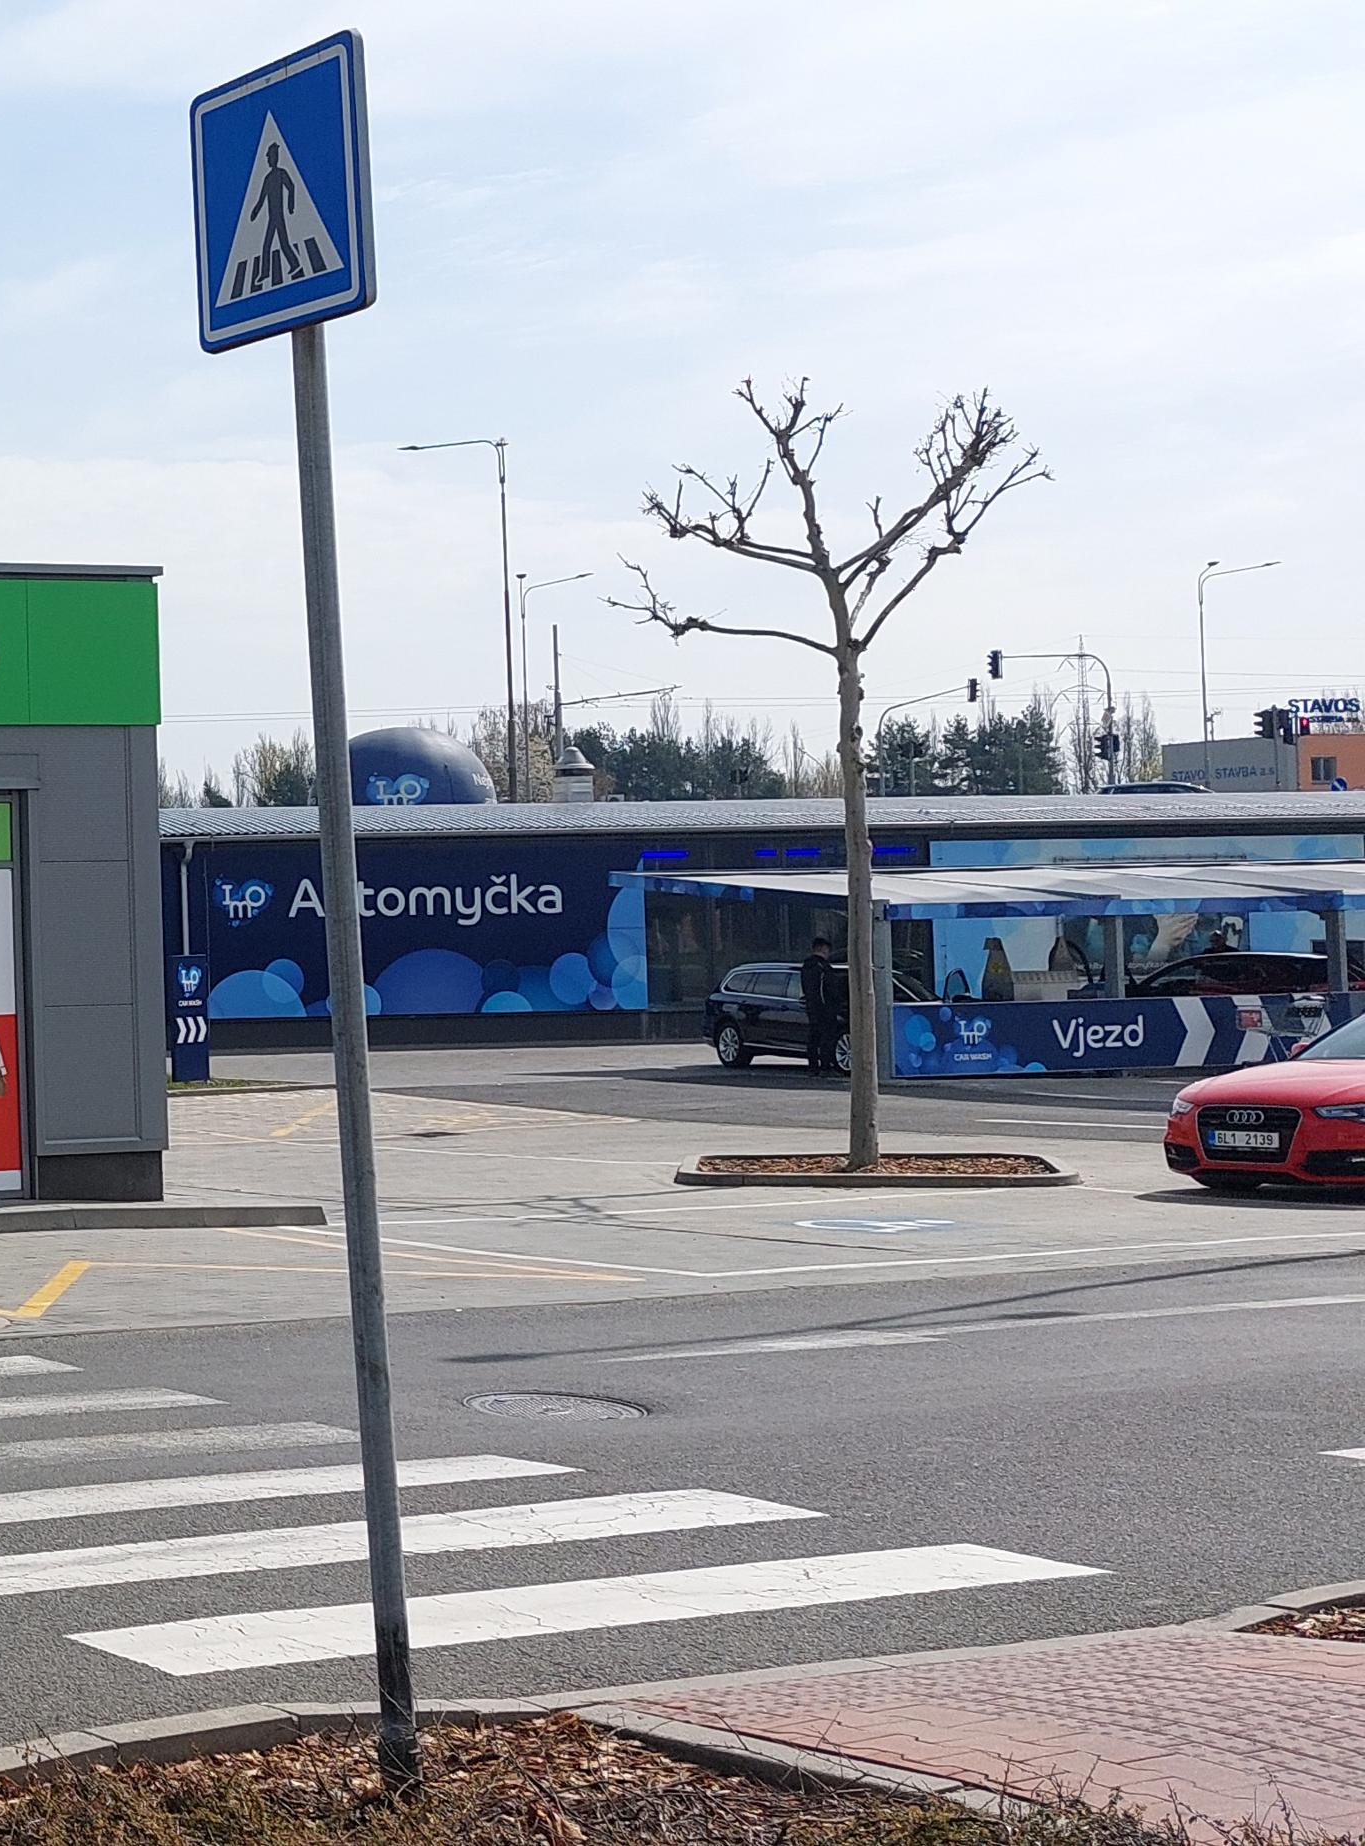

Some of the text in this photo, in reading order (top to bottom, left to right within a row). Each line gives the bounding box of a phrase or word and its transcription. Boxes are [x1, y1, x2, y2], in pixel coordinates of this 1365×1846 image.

[1287, 697, 1361, 713] STAVOS
[1172, 768, 1206, 782] STAVO
[1215, 765, 1257, 779] STAVBA
[288, 873, 563, 926] Atomyčka
[1052, 1015, 1144, 1058] Vjezd
[1245, 1133, 1274, 1146] 2139
